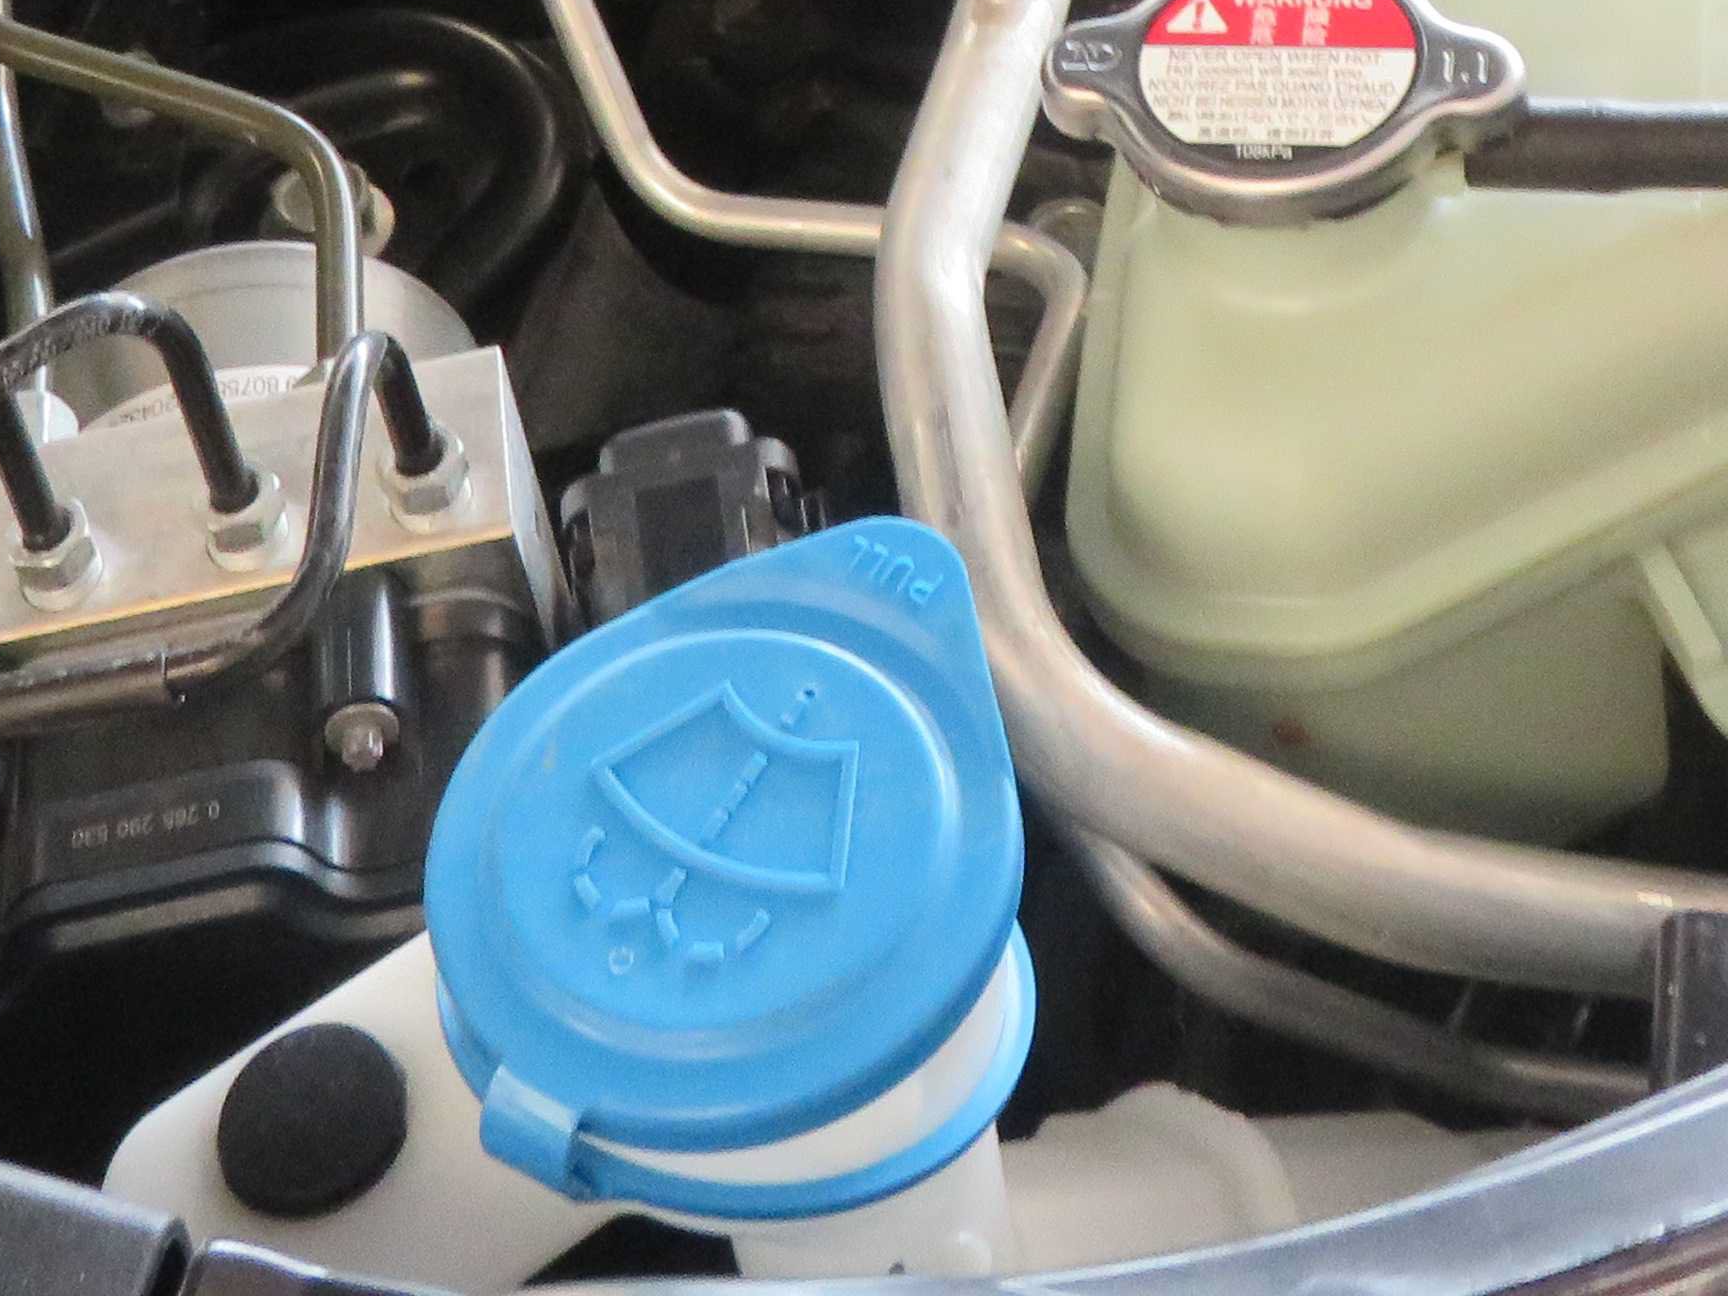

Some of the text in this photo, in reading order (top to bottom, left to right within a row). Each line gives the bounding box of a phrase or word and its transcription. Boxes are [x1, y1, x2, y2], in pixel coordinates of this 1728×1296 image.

[1169, 48, 1230, 64] NEVER
[1232, 49, 1281, 65] OPEN
[1287, 50, 1340, 66] WHEN
[1443, 50, 1488, 84] 1.1
[850, 534, 944, 607] PULL
